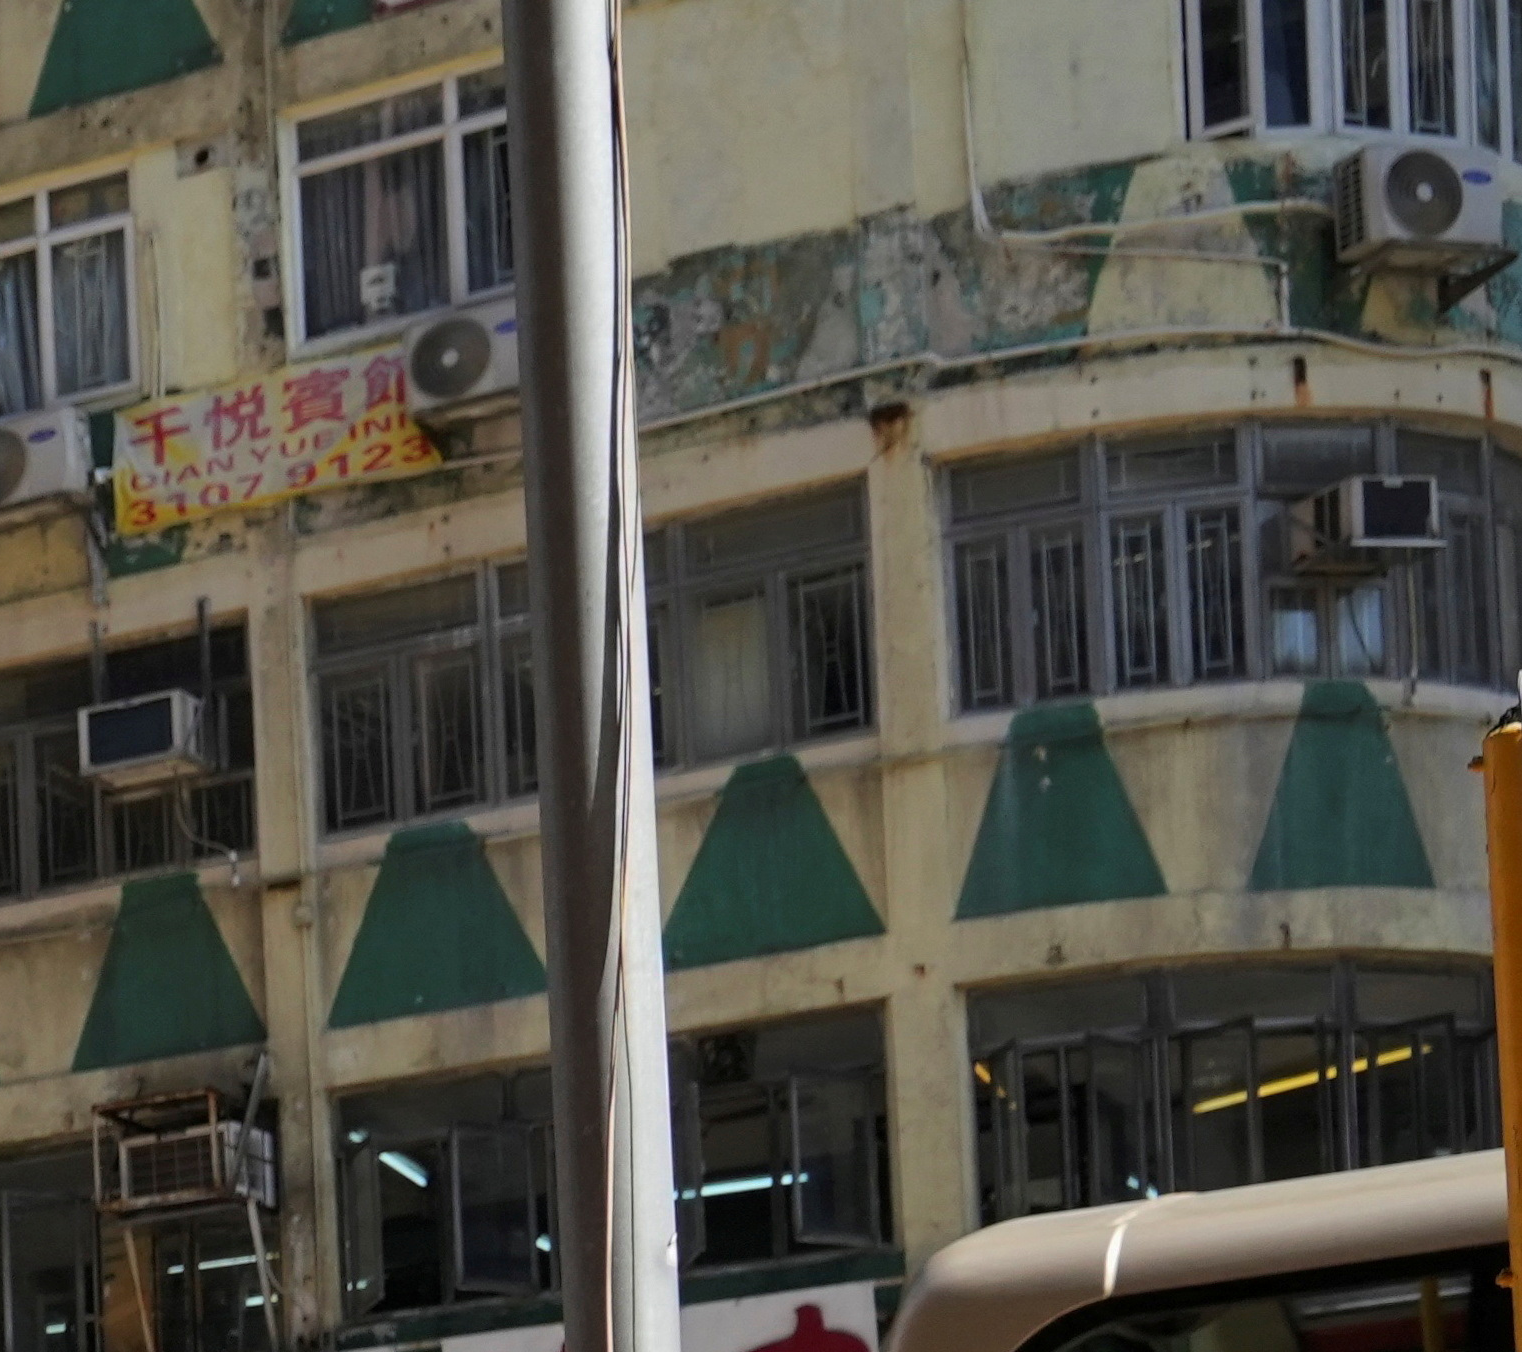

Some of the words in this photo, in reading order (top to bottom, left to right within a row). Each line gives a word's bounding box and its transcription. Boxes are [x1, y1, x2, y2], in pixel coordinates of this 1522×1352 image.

[348, 414, 407, 441] IN
[130, 473, 263, 527] 3107
[286, 434, 432, 490] 9123
